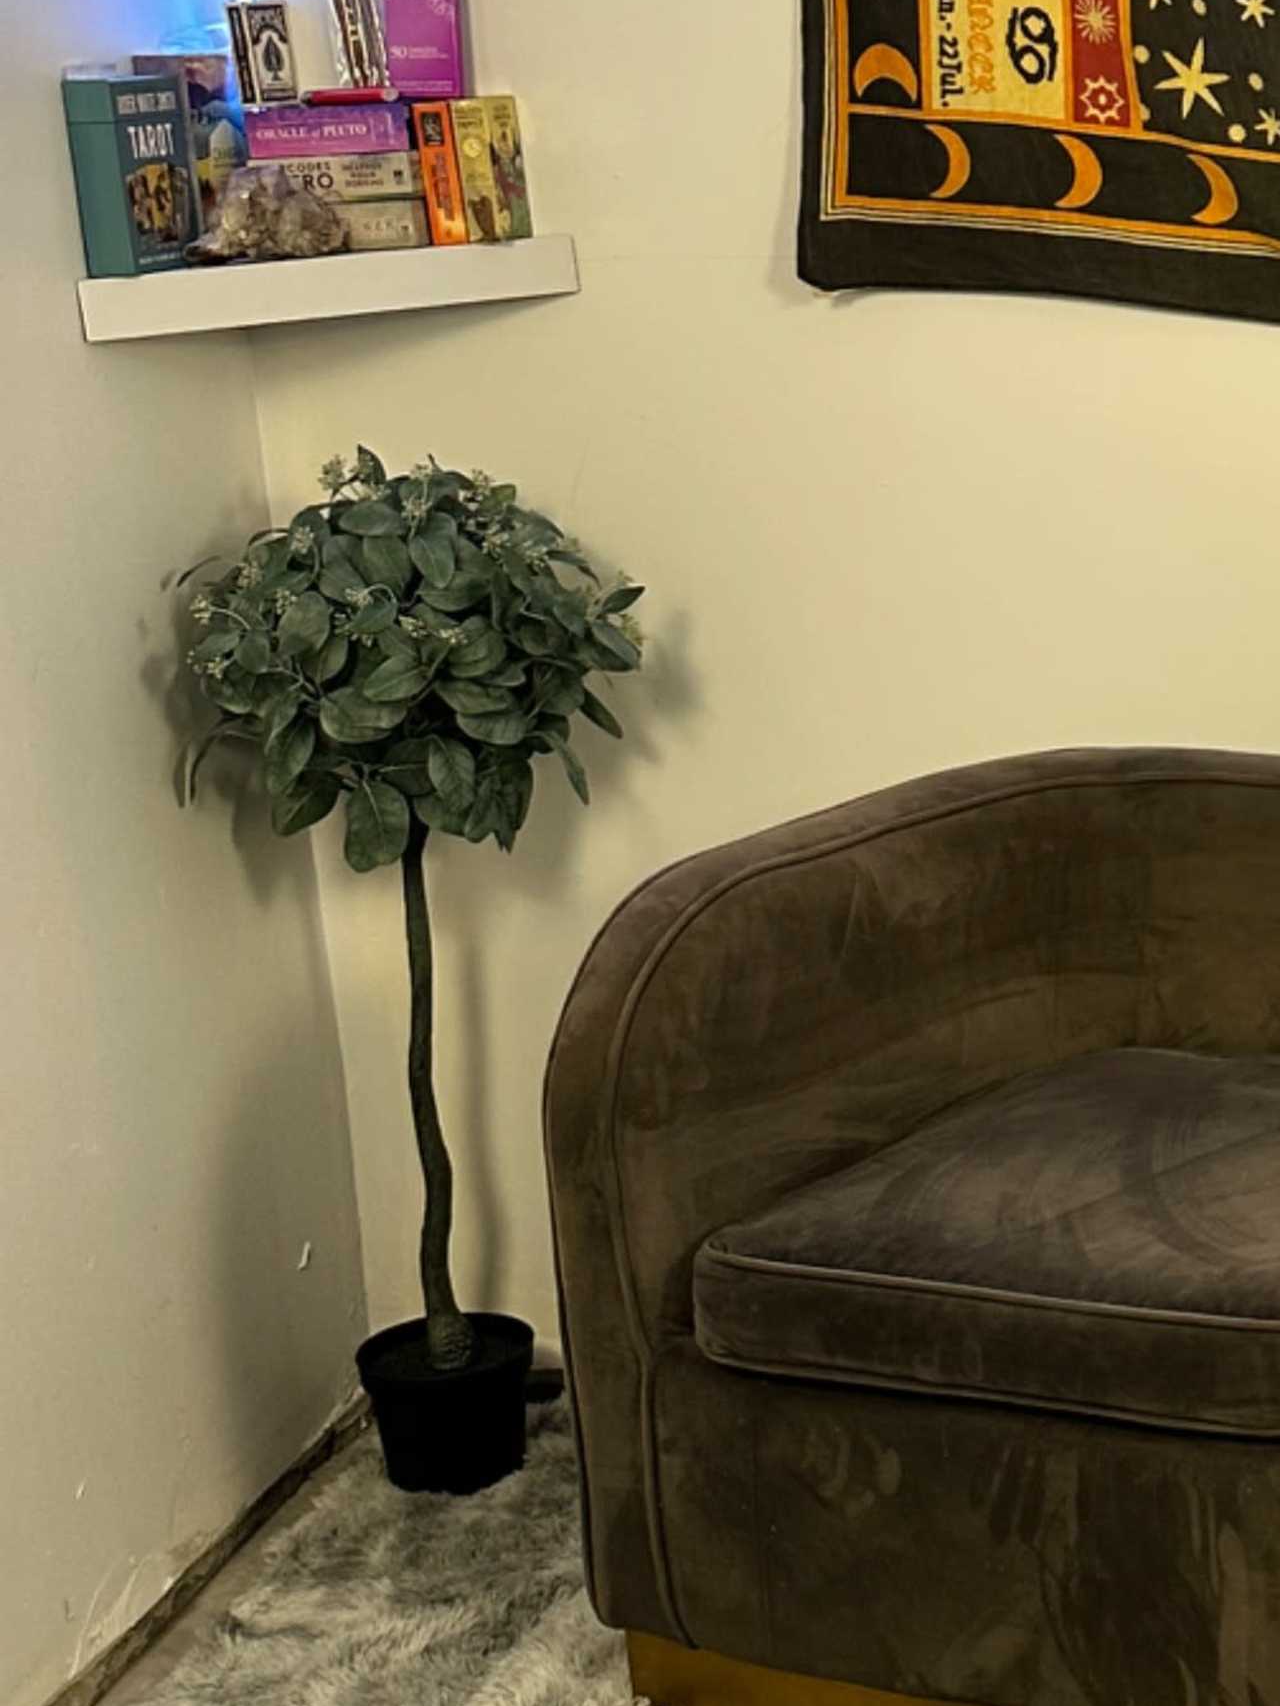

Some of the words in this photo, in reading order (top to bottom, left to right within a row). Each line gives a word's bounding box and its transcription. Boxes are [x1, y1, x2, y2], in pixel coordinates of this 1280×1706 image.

[127, 122, 174, 160] TAROT
[255, 127, 308, 140] ORACLE
[322, 123, 367, 138] PLUTO
